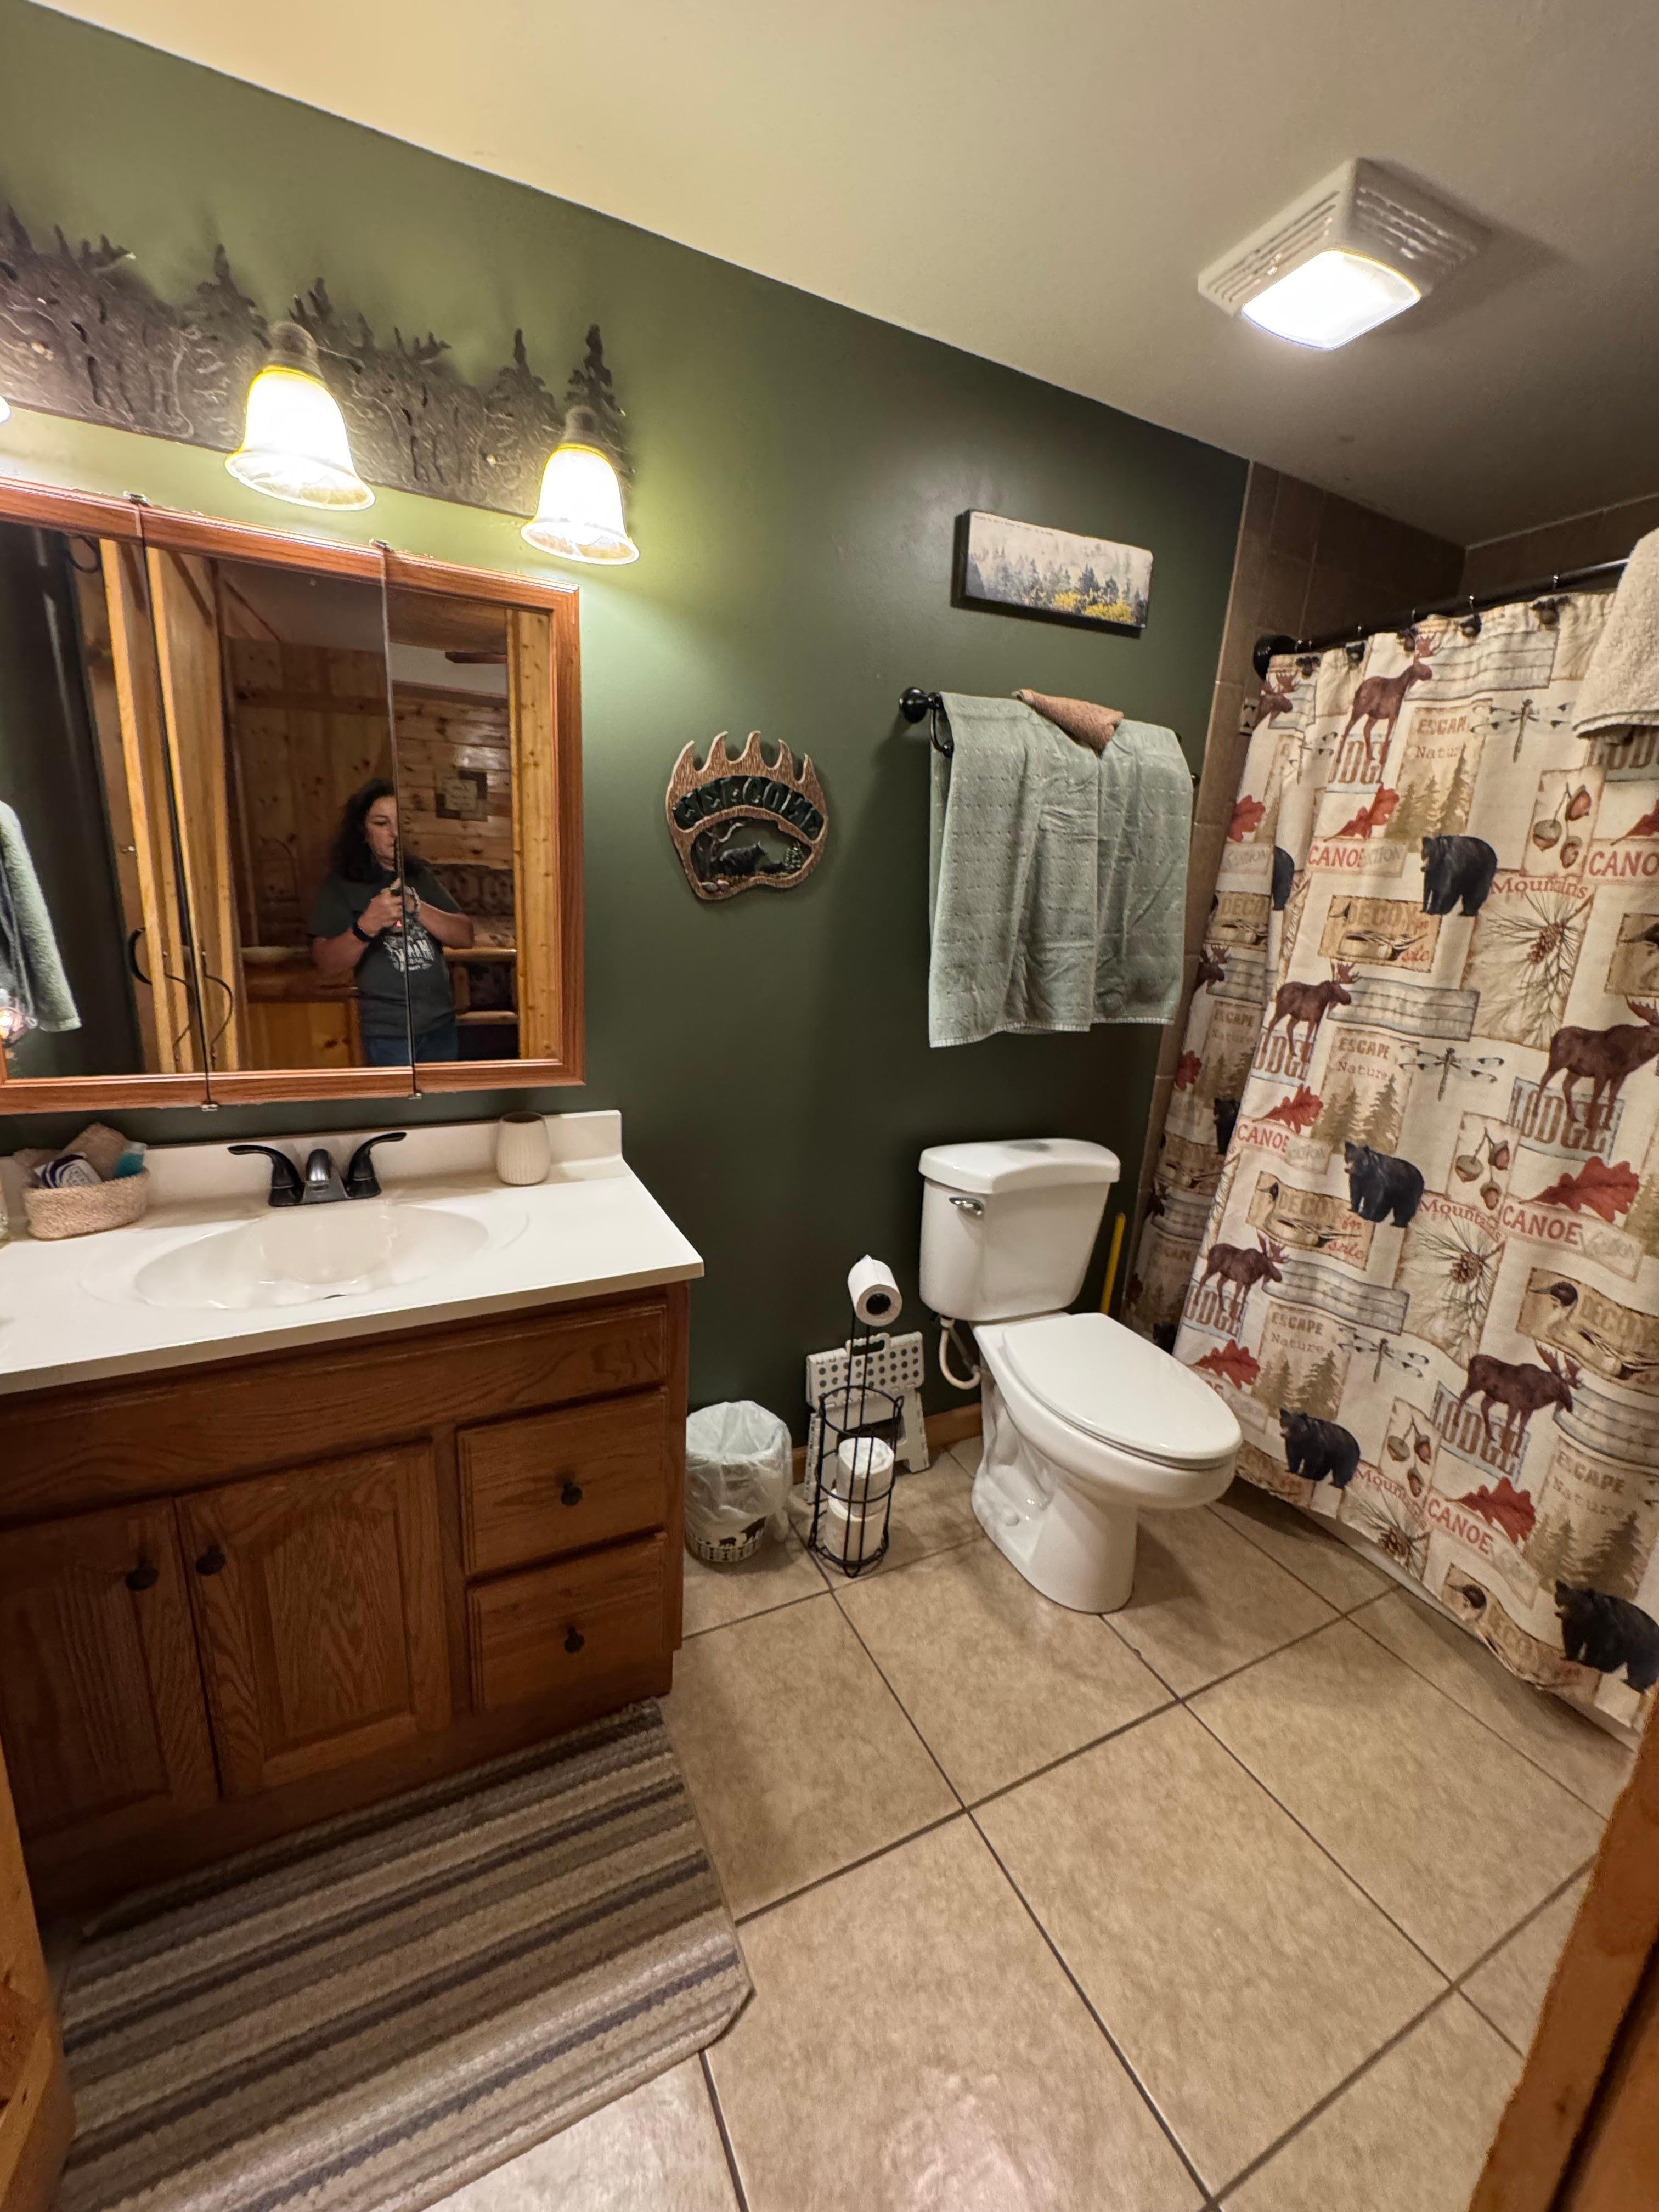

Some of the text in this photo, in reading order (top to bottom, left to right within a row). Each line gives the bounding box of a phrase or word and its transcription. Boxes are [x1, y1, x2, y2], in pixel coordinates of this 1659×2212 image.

[1338, 1036, 1390, 1060] ESCAPE
[1336, 1060, 1388, 1081] Nature
[1501, 1205, 1583, 1245] CANOE
[1271, 1311, 1324, 1335] ESCAPE
[1269, 1332, 1325, 1355] Nature
[1427, 1499, 1494, 1554] CANOE
